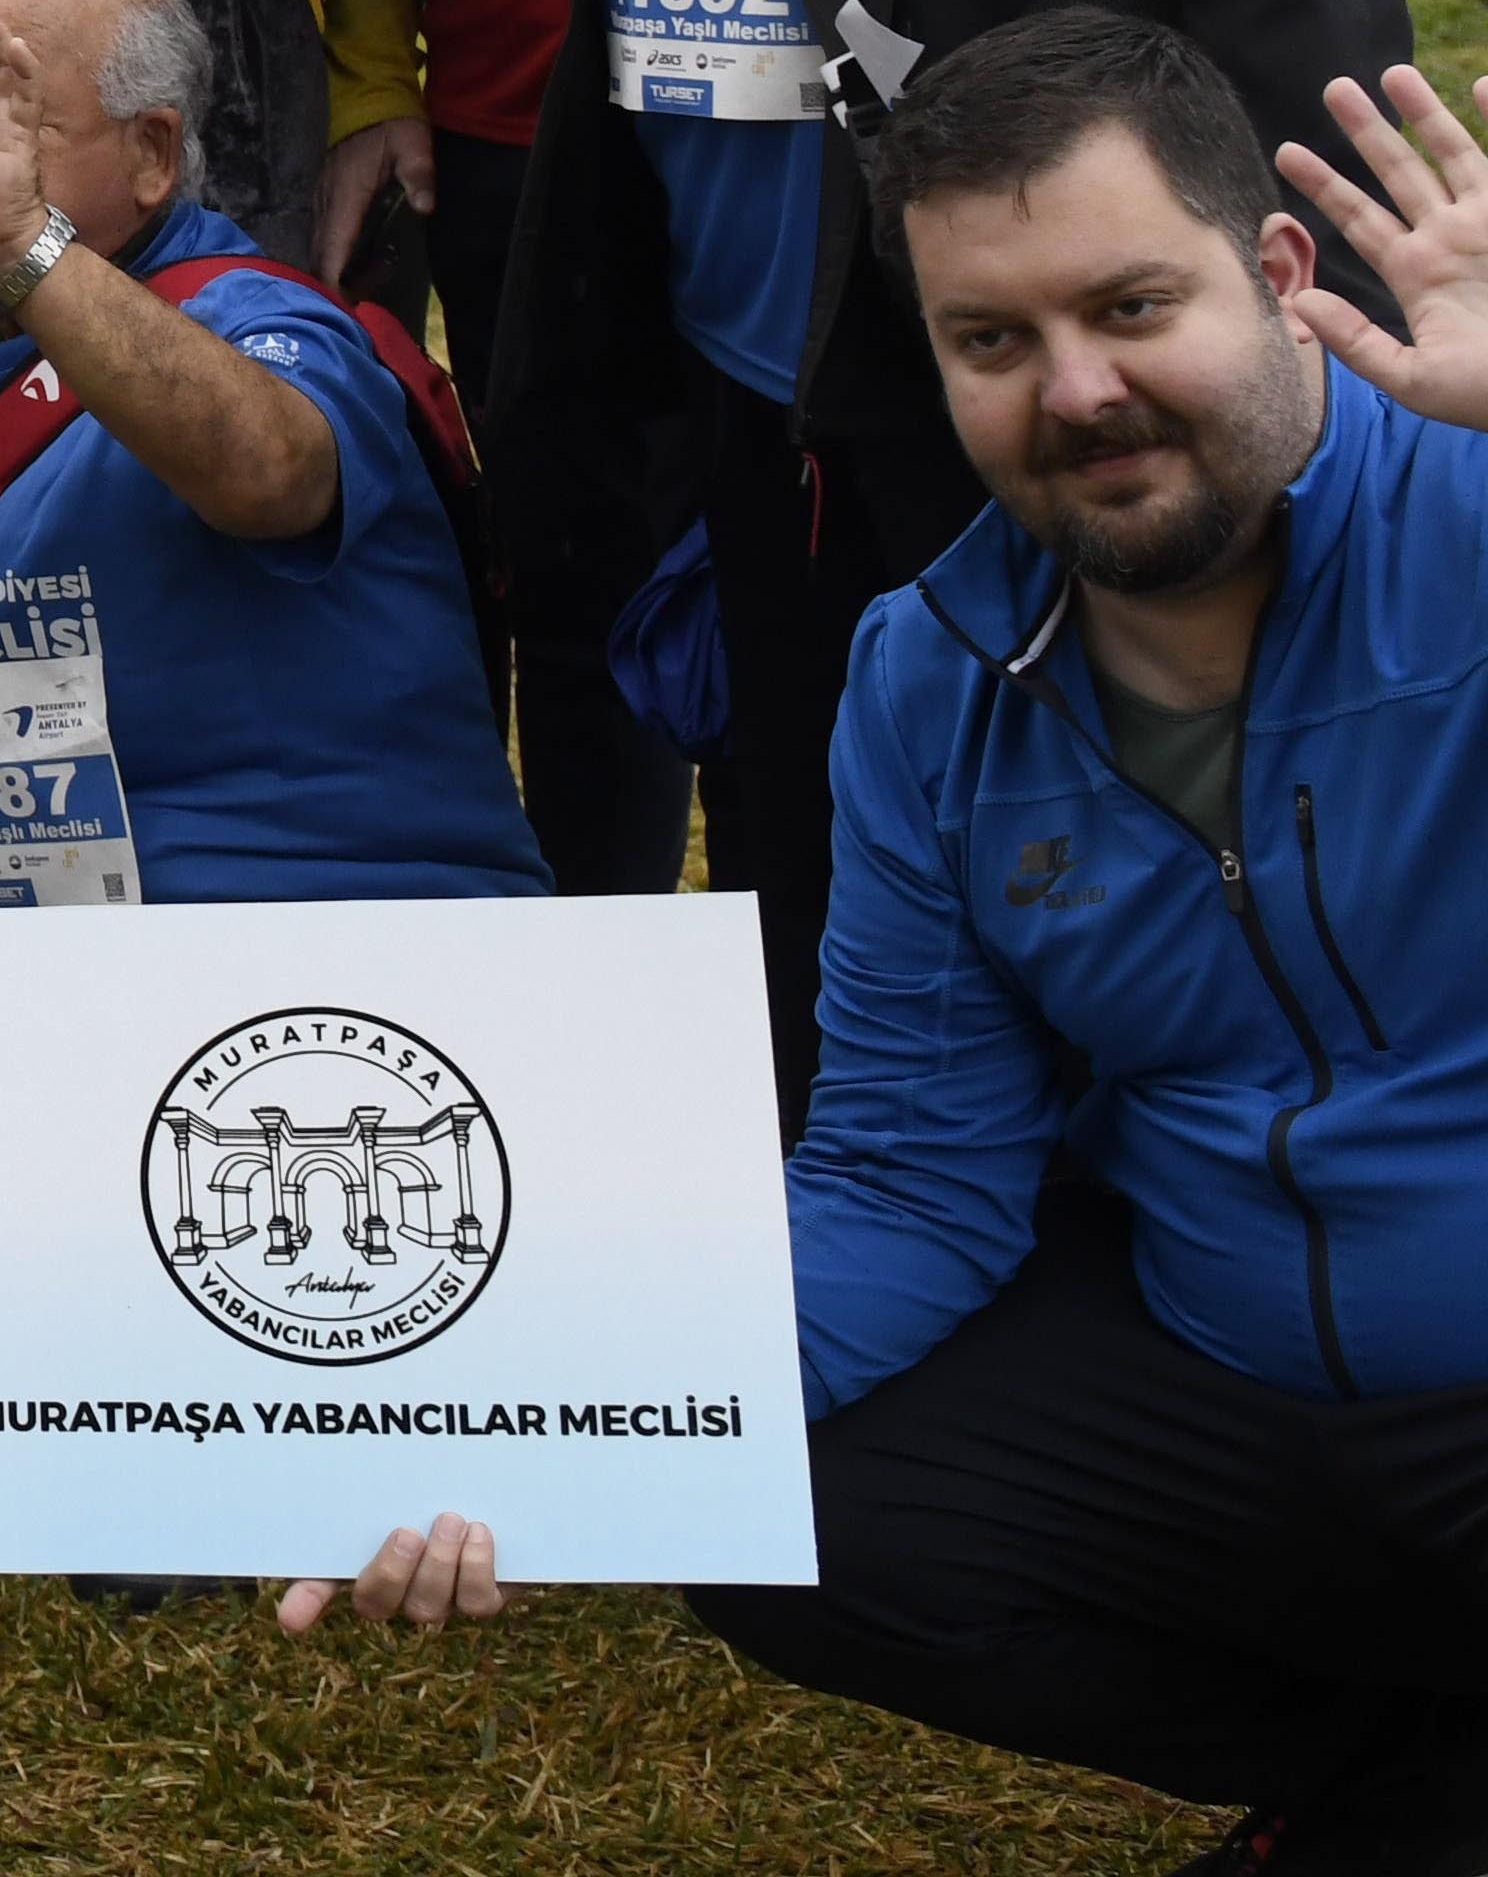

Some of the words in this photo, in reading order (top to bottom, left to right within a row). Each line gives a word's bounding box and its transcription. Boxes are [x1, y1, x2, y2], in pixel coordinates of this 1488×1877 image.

[671, 17, 716, 42] Yaşlı
[724, 20, 809, 41] Meclisi
[36, 701, 74, 711] PRESENTED
[38, 718, 83, 731] ANTALYA
[38, 731, 64, 740] Airport
[30, 818, 102, 839] Meclisi
[193, 1024, 441, 1092] MURATPAŞA
[285, 1266, 376, 1310] Antalya
[199, 1271, 366, 1350] YABANCILAR
[371, 1272, 465, 1345] MECLİSİ
[254, 1401, 546, 1438] YABANCILAR
[559, 1393, 743, 1439] MECLİSİ
